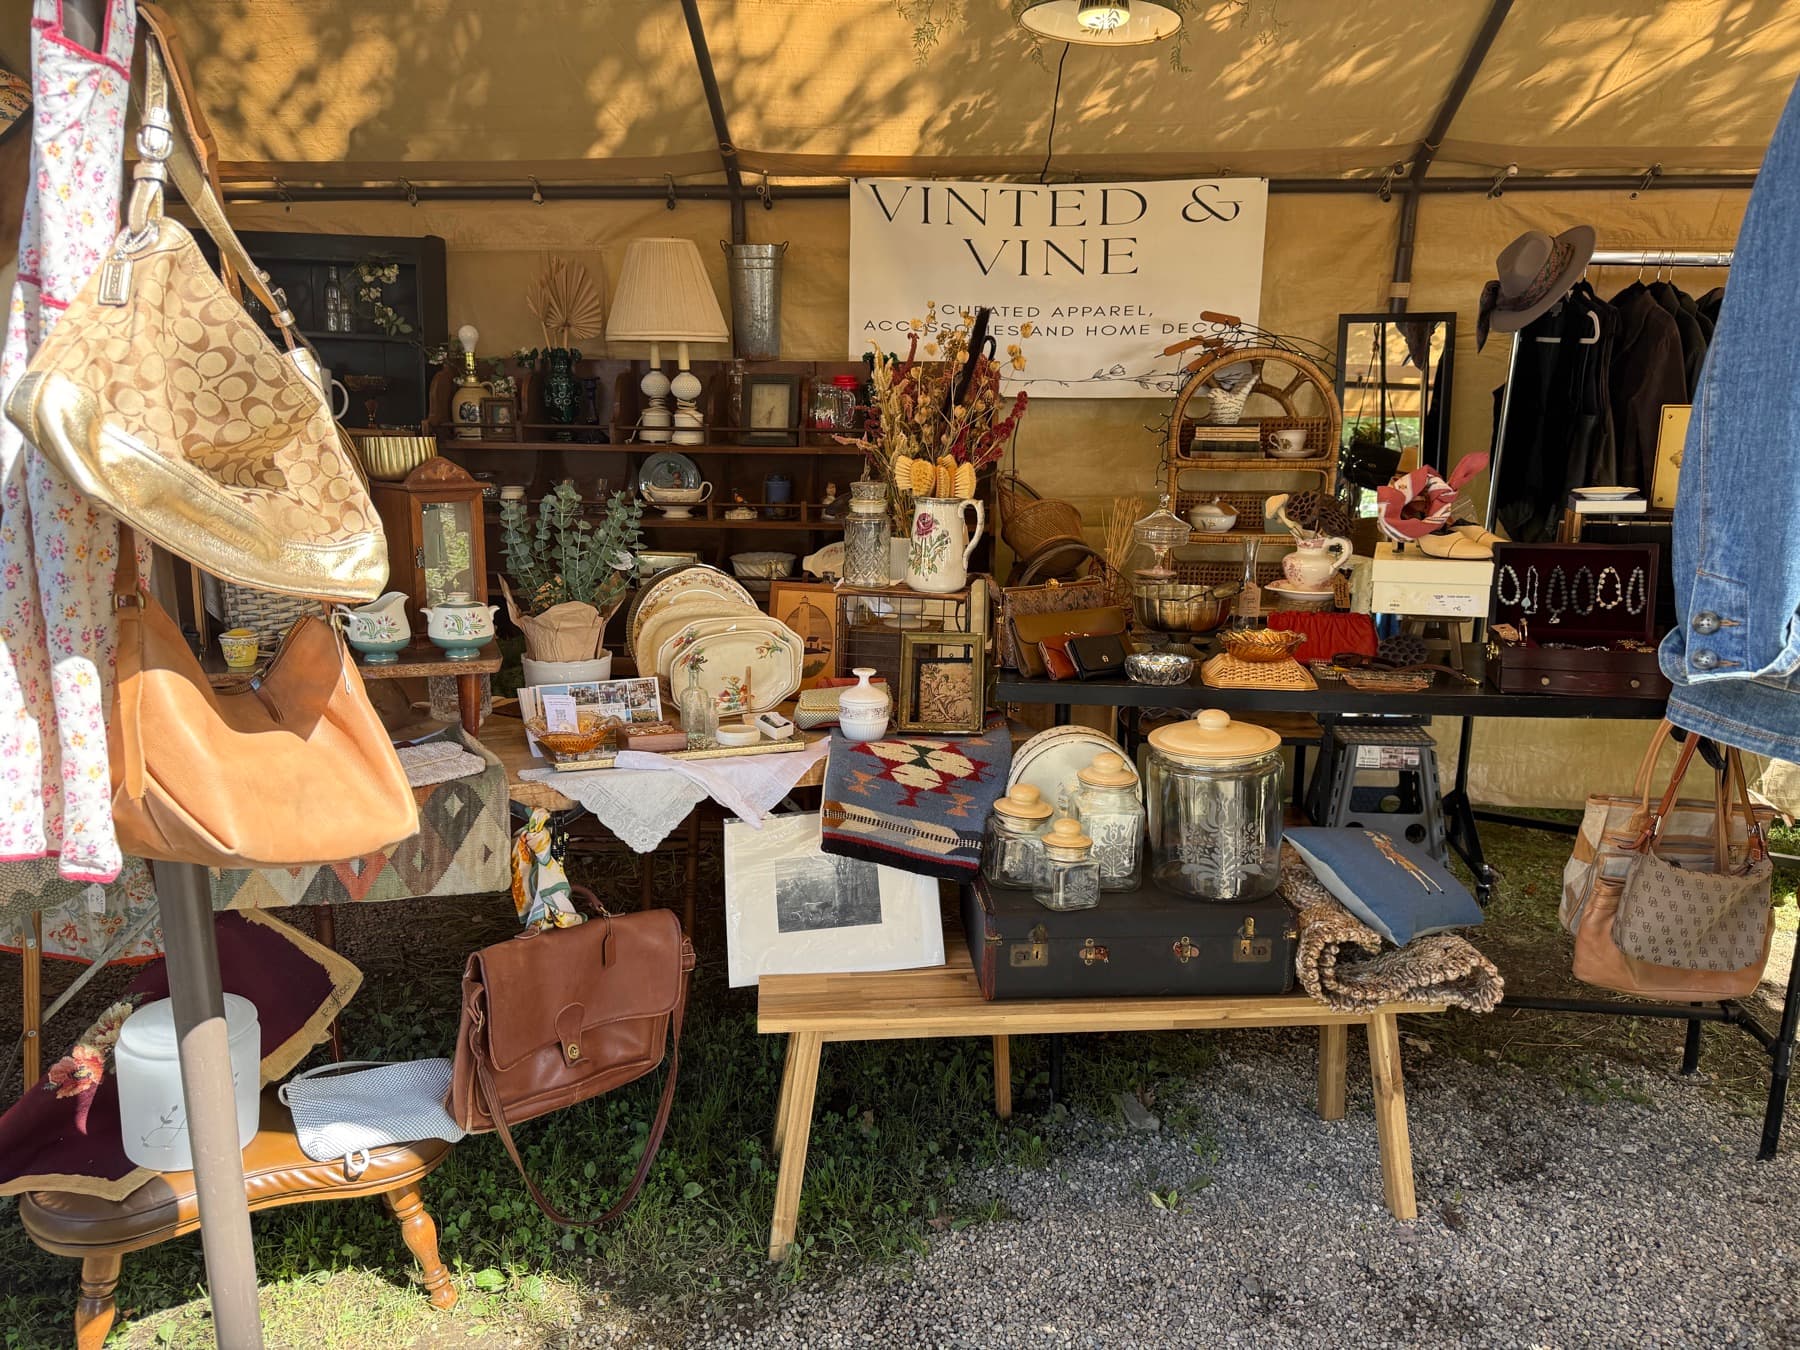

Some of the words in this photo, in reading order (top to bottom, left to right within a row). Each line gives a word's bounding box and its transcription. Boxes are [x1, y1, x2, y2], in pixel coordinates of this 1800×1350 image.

[868, 184, 1148, 227] VINTED
[1181, 184, 1243, 223] &
[963, 237, 1139, 277] VINE
[1050, 305, 1154, 318] APPAREL,
[864, 319, 1020, 337] ACCSSOIES
[1031, 324, 1075, 337] AND
[1086, 323, 1151, 336] HOME
